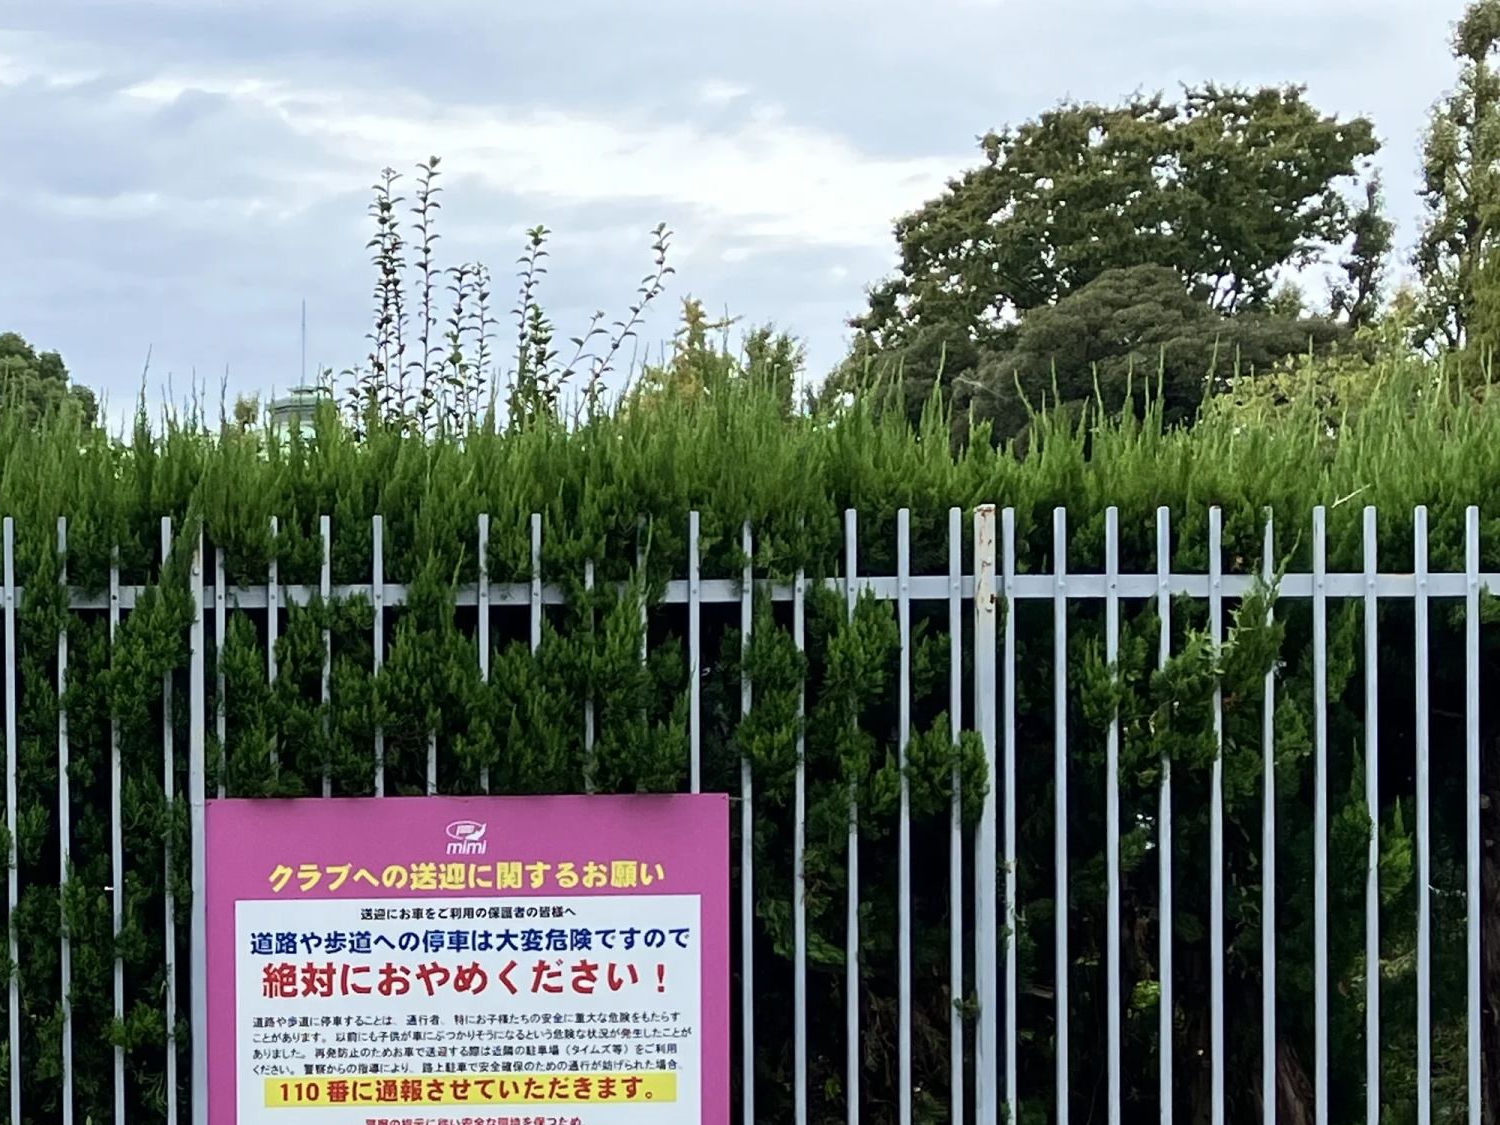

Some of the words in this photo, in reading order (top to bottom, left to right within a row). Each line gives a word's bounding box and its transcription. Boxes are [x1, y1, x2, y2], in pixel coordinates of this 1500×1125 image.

[268, 860, 666, 892] クラブへの送迎に関するお願い
[360, 905, 577, 921] 送迎にお車をご利用の保護者の皆様へ
[250, 927, 690, 955] 道路や歩道への停車は大変危険ですので
[262, 959, 667, 999] 絶対におやめください！
